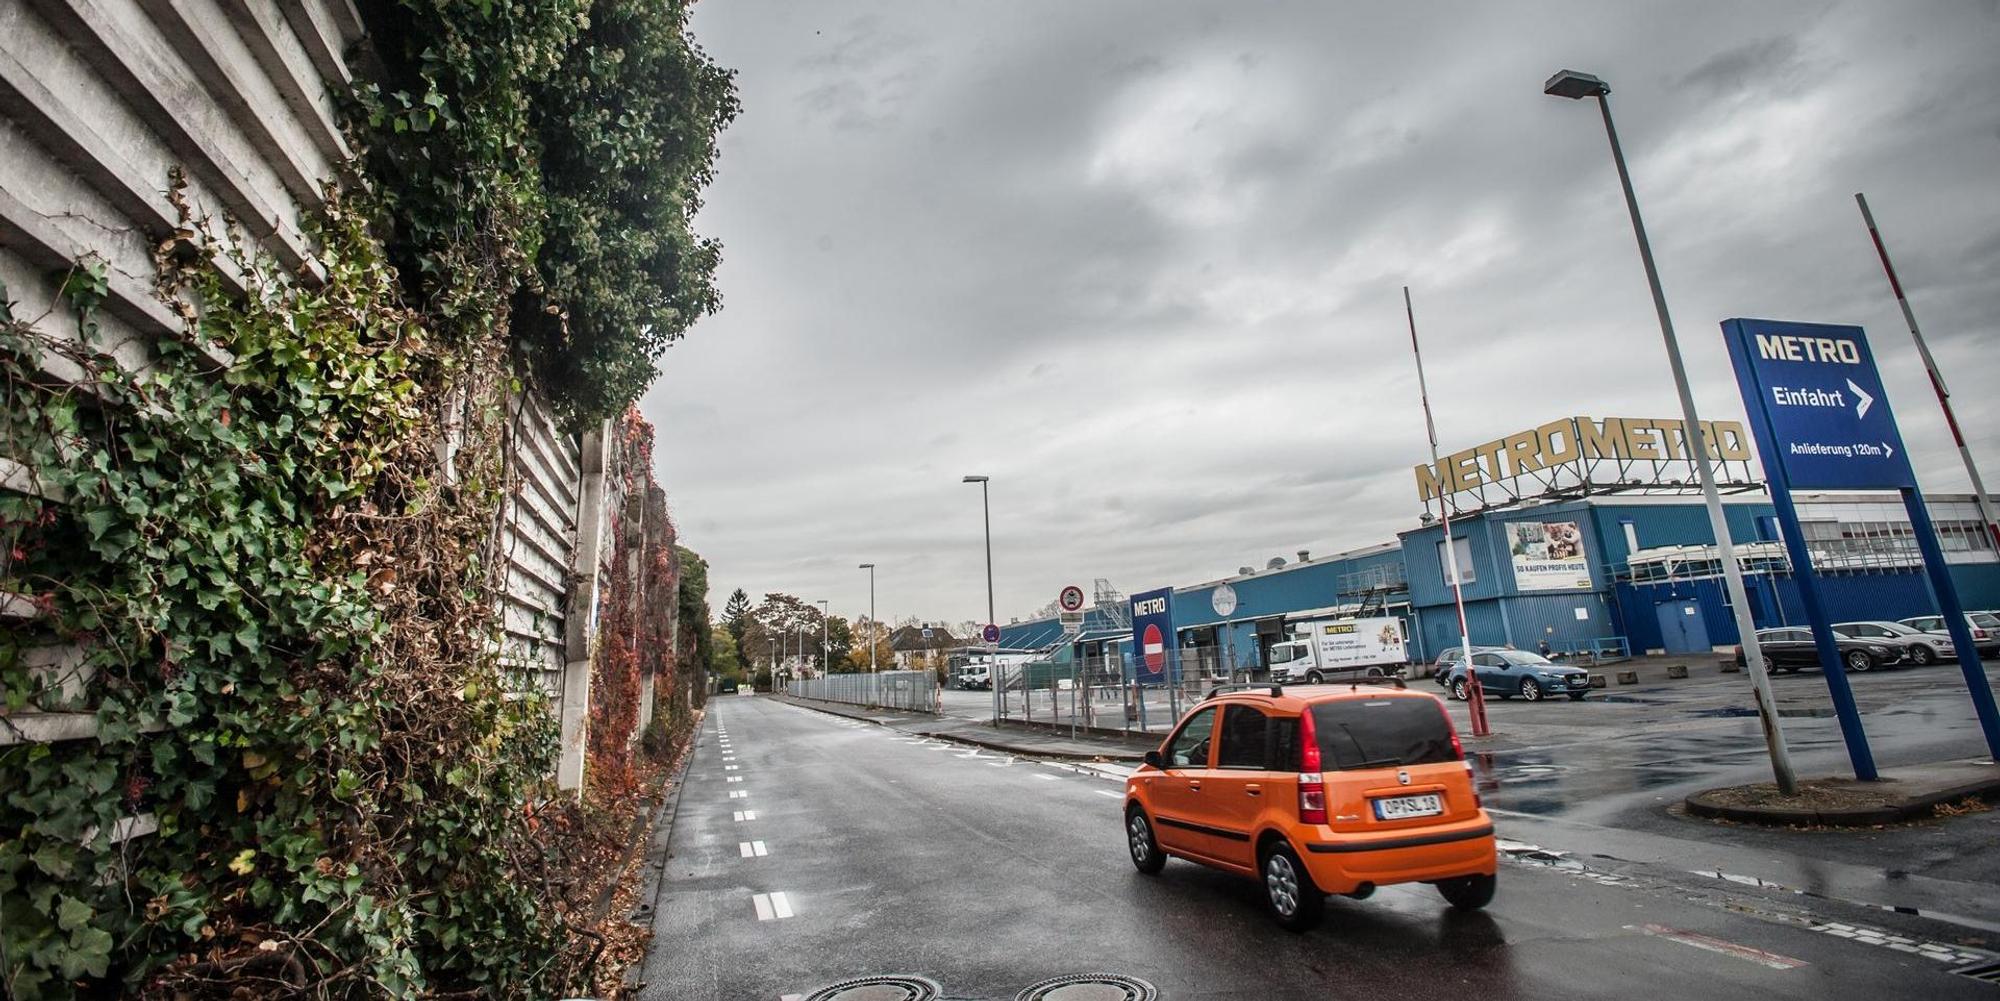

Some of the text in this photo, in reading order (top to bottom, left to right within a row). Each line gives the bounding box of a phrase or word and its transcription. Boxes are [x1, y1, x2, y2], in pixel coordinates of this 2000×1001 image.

[1755, 334, 1860, 365] METRO
[1772, 386, 1845, 407] Einfahrt
[1575, 416, 1751, 461] METRO
[1414, 417, 1582, 502] METRO
[1790, 442, 1882, 458] Anlieferung 120m
[1525, 564, 1547, 573] KAUFEN
[1548, 563, 1567, 572] PROFIS
[1568, 563, 1585, 571] HEUTE
[1134, 597, 1166, 617] METRO
[1326, 625, 1353, 634] METRO
